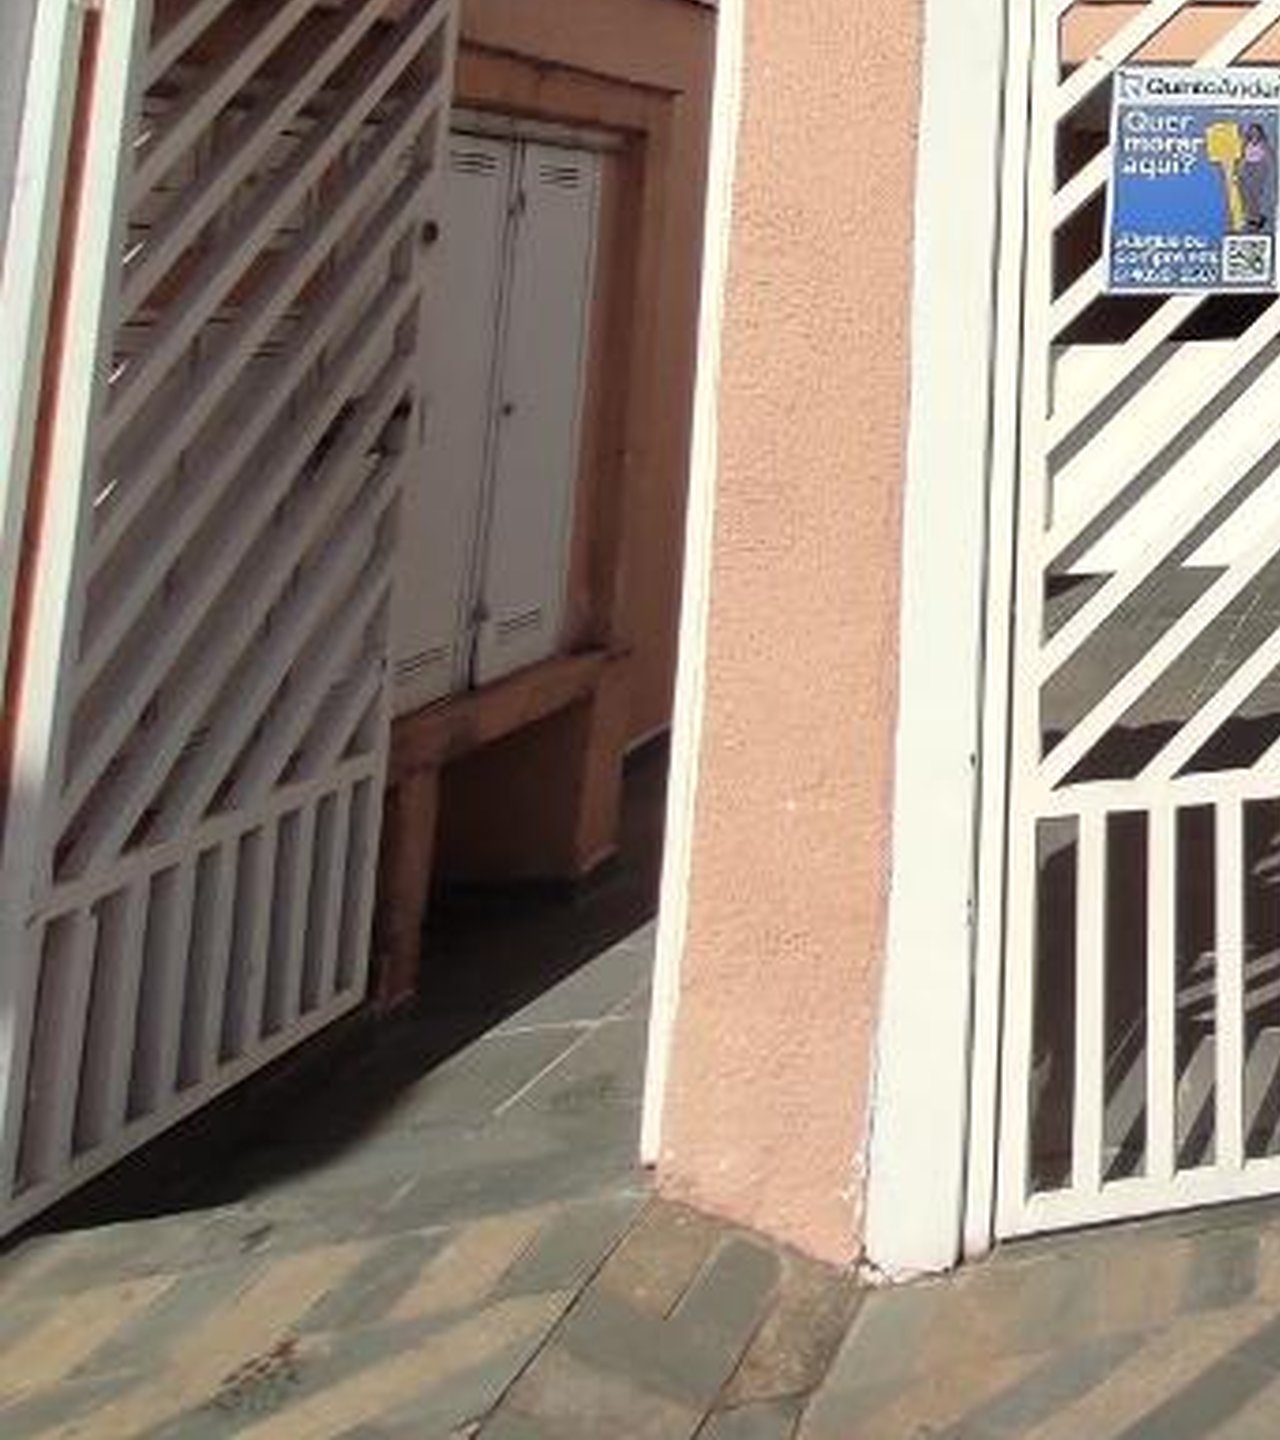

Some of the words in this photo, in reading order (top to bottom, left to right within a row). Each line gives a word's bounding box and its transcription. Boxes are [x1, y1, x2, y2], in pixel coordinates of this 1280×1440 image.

[1126, 111, 1195, 133] Quer
[1123, 136, 1204, 154] morar
[1122, 154, 1197, 180] aqui?
